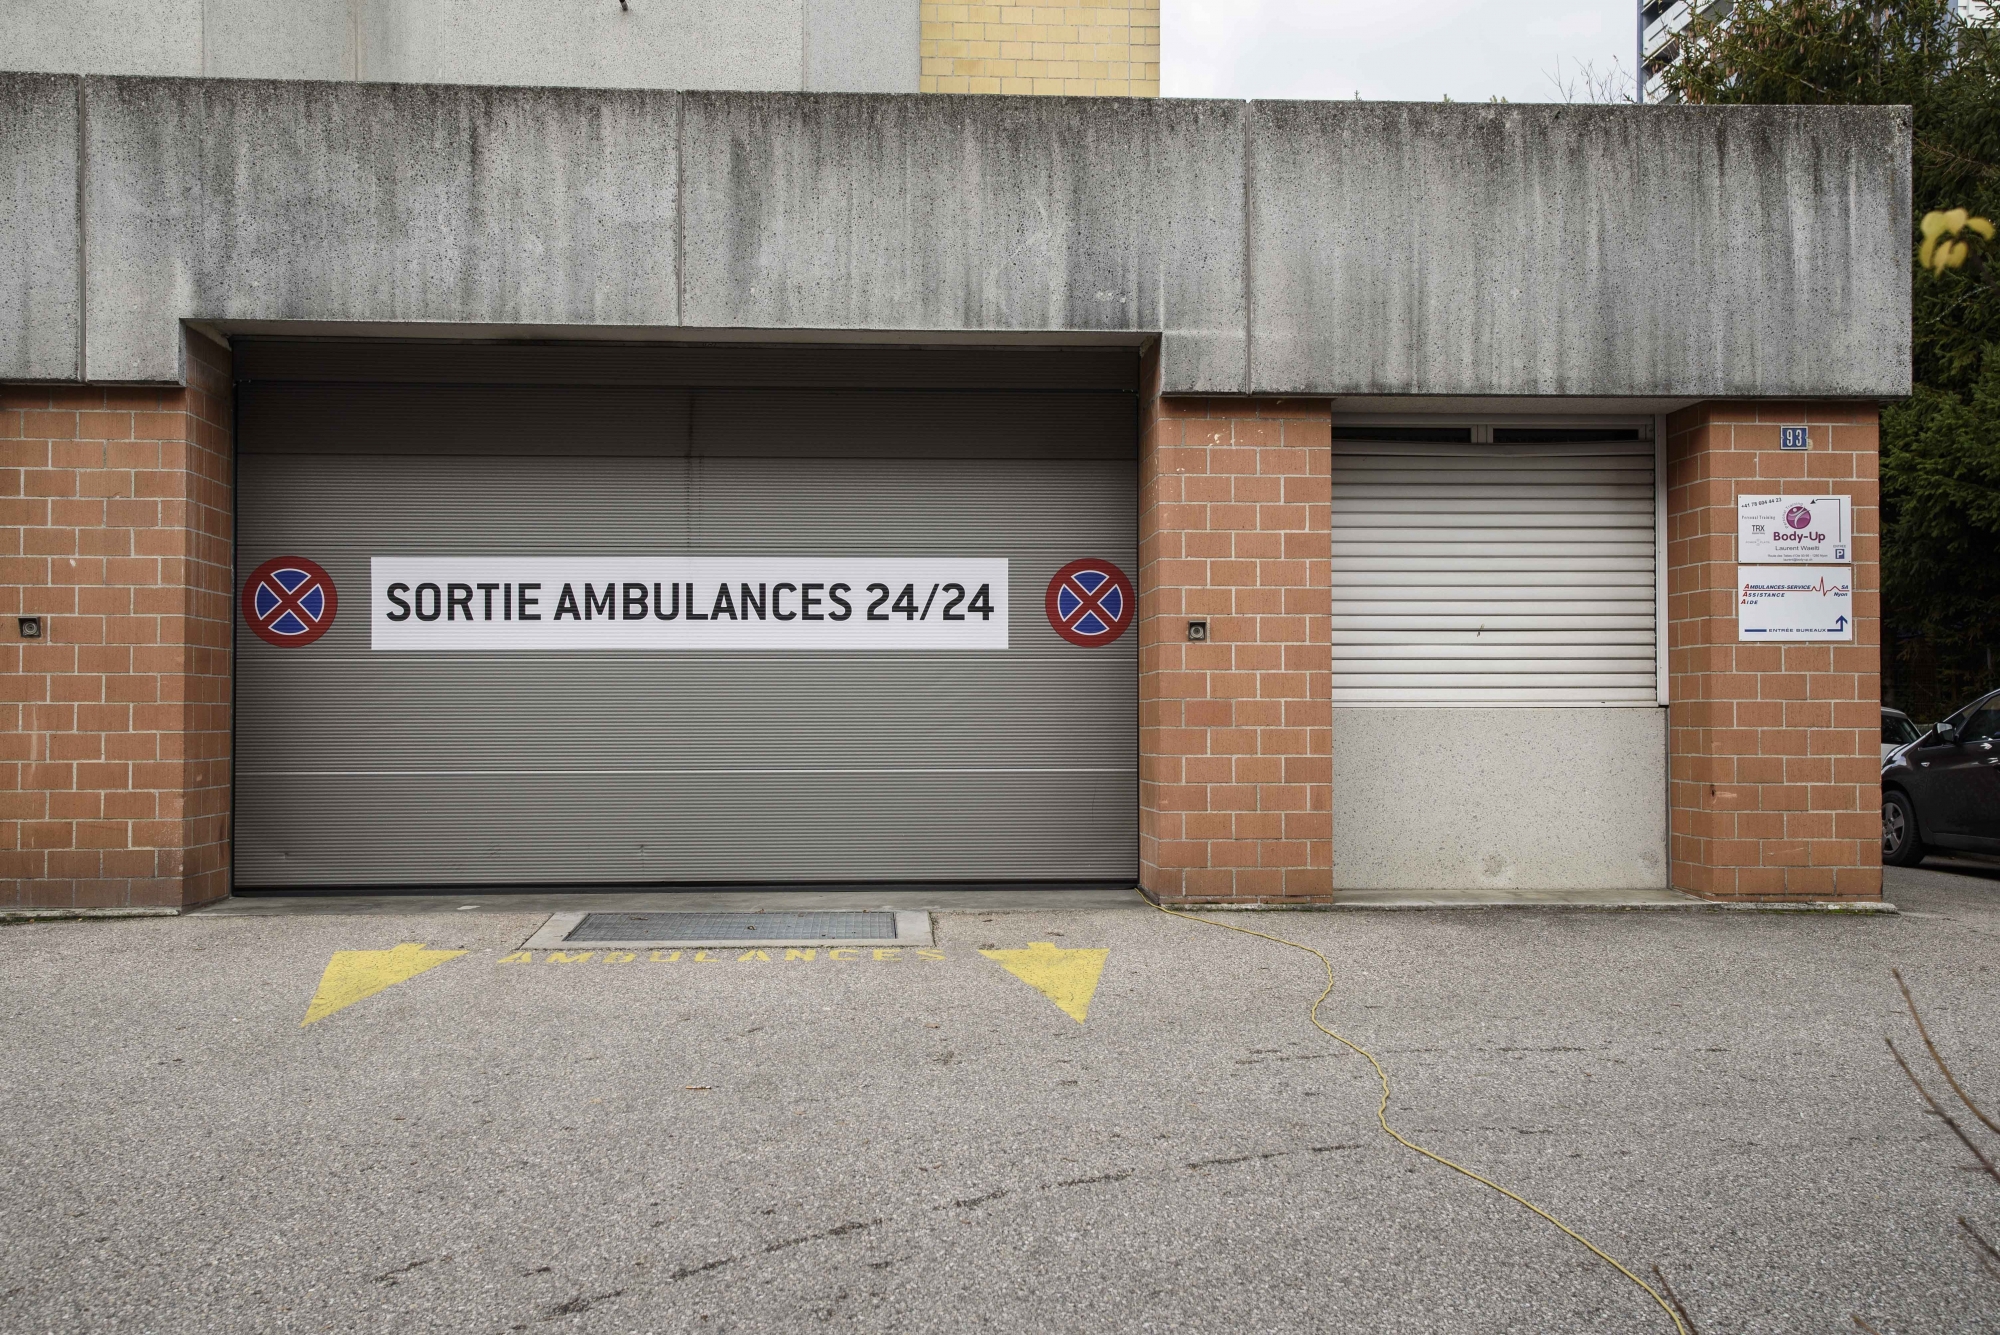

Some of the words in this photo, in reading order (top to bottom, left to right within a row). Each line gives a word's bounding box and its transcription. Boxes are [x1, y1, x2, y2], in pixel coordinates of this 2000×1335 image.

[1786, 429, 1802, 447] 93
[1773, 531, 1826, 544] Body-Up
[385, 582, 542, 622] SORTIE
[552, 582, 852, 622] AMBULANCES
[865, 582, 995, 622] 24/24
[496, 948, 948, 965] AMBULANCES
